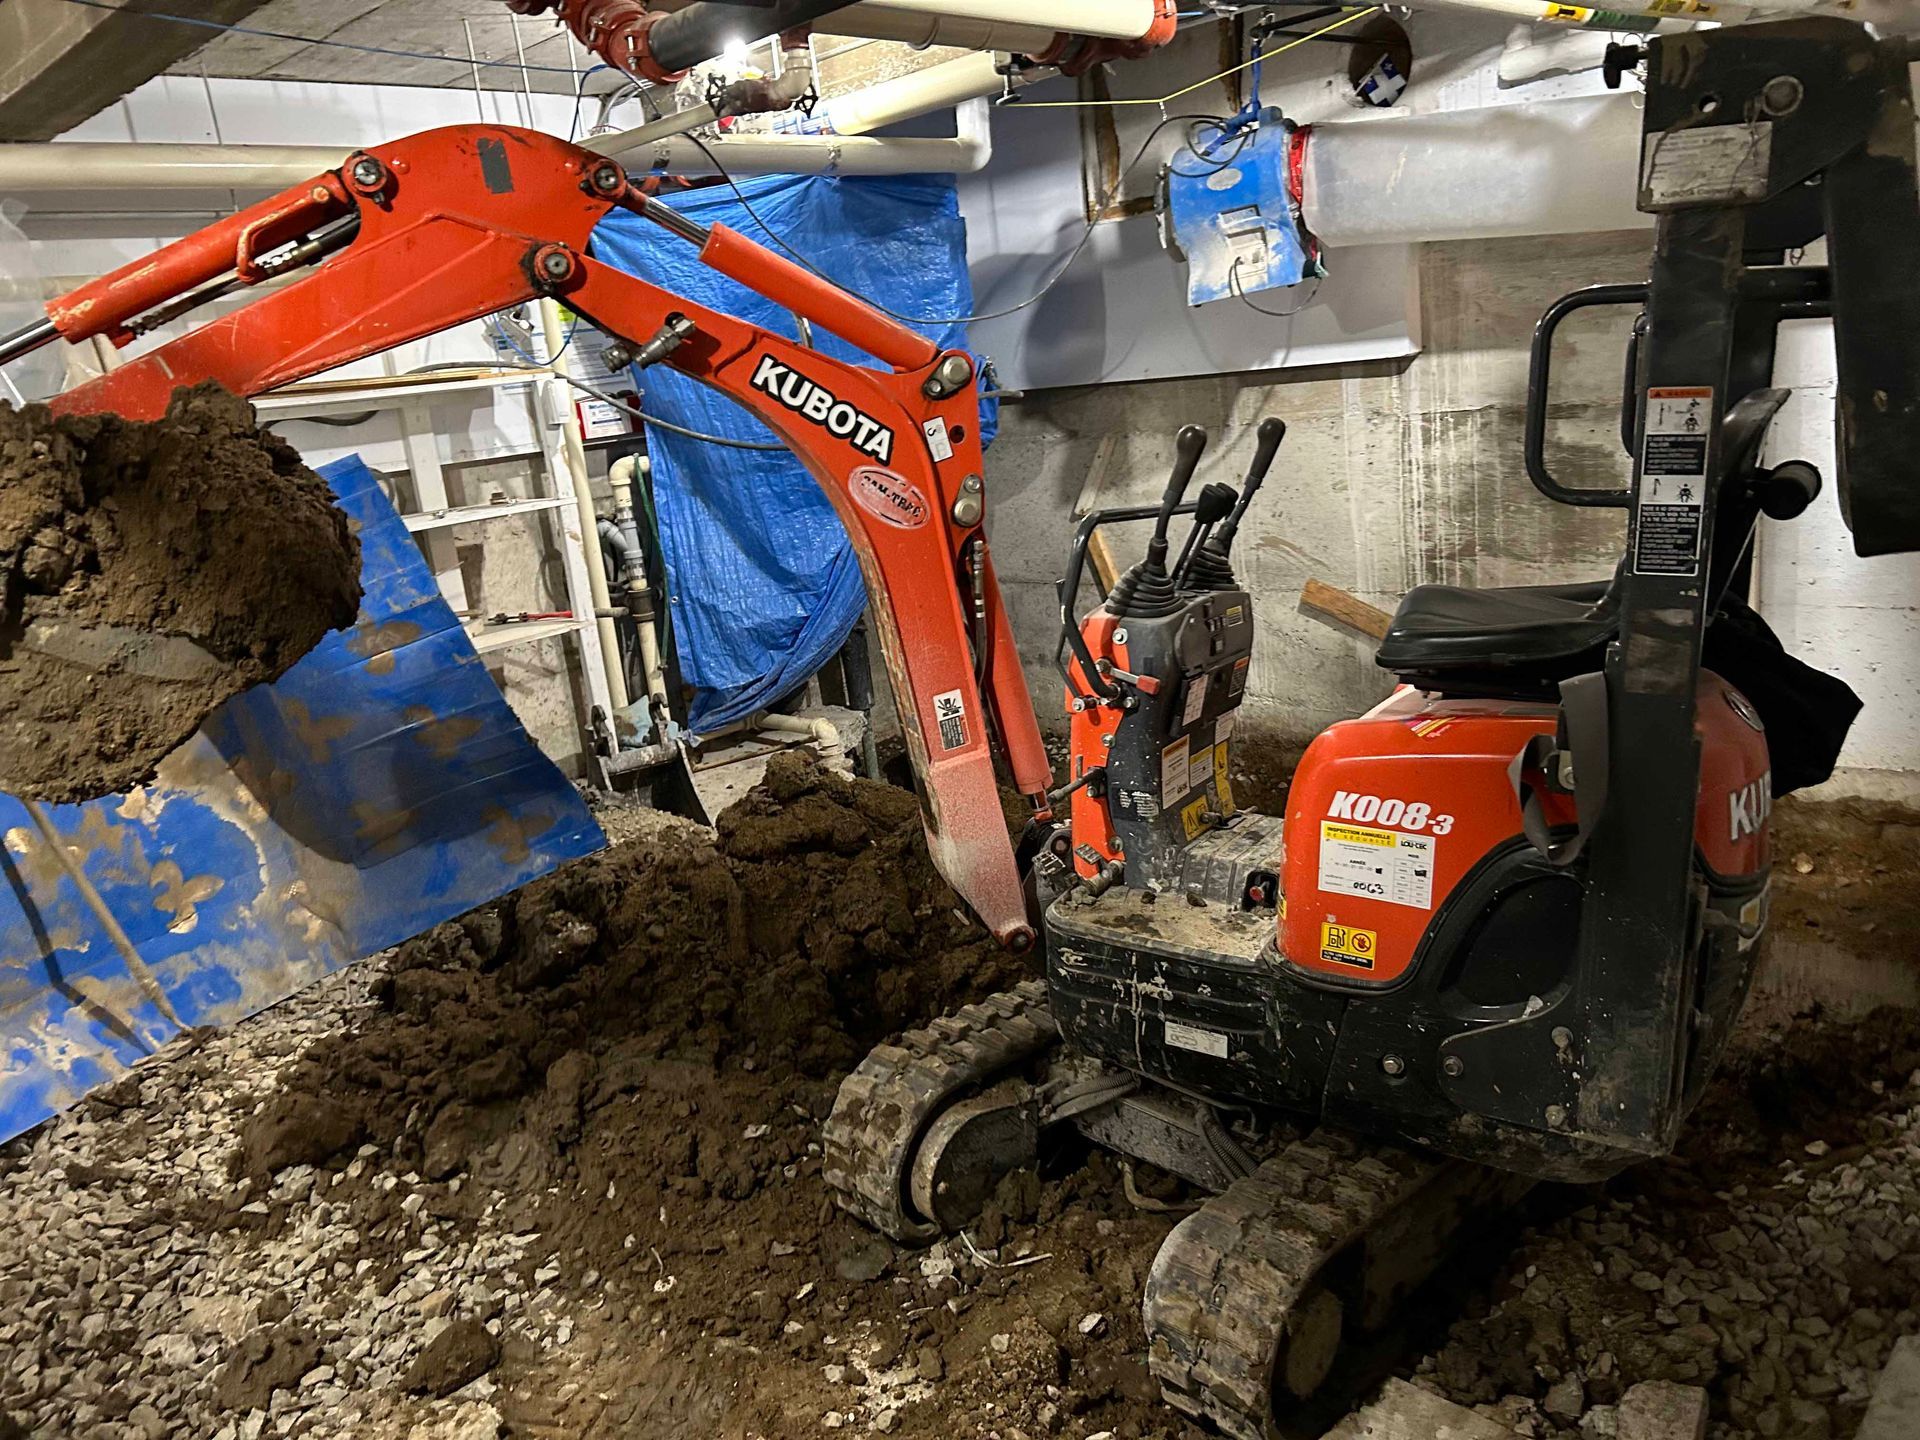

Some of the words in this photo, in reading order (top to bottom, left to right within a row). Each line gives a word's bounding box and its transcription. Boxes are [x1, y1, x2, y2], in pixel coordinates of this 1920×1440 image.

[751, 355, 893, 464] KUBOTA
[1327, 790, 1455, 835] K008-3
[1327, 826, 1361, 836] INSPECTION
[1361, 831, 1391, 841] ANNUELLE
